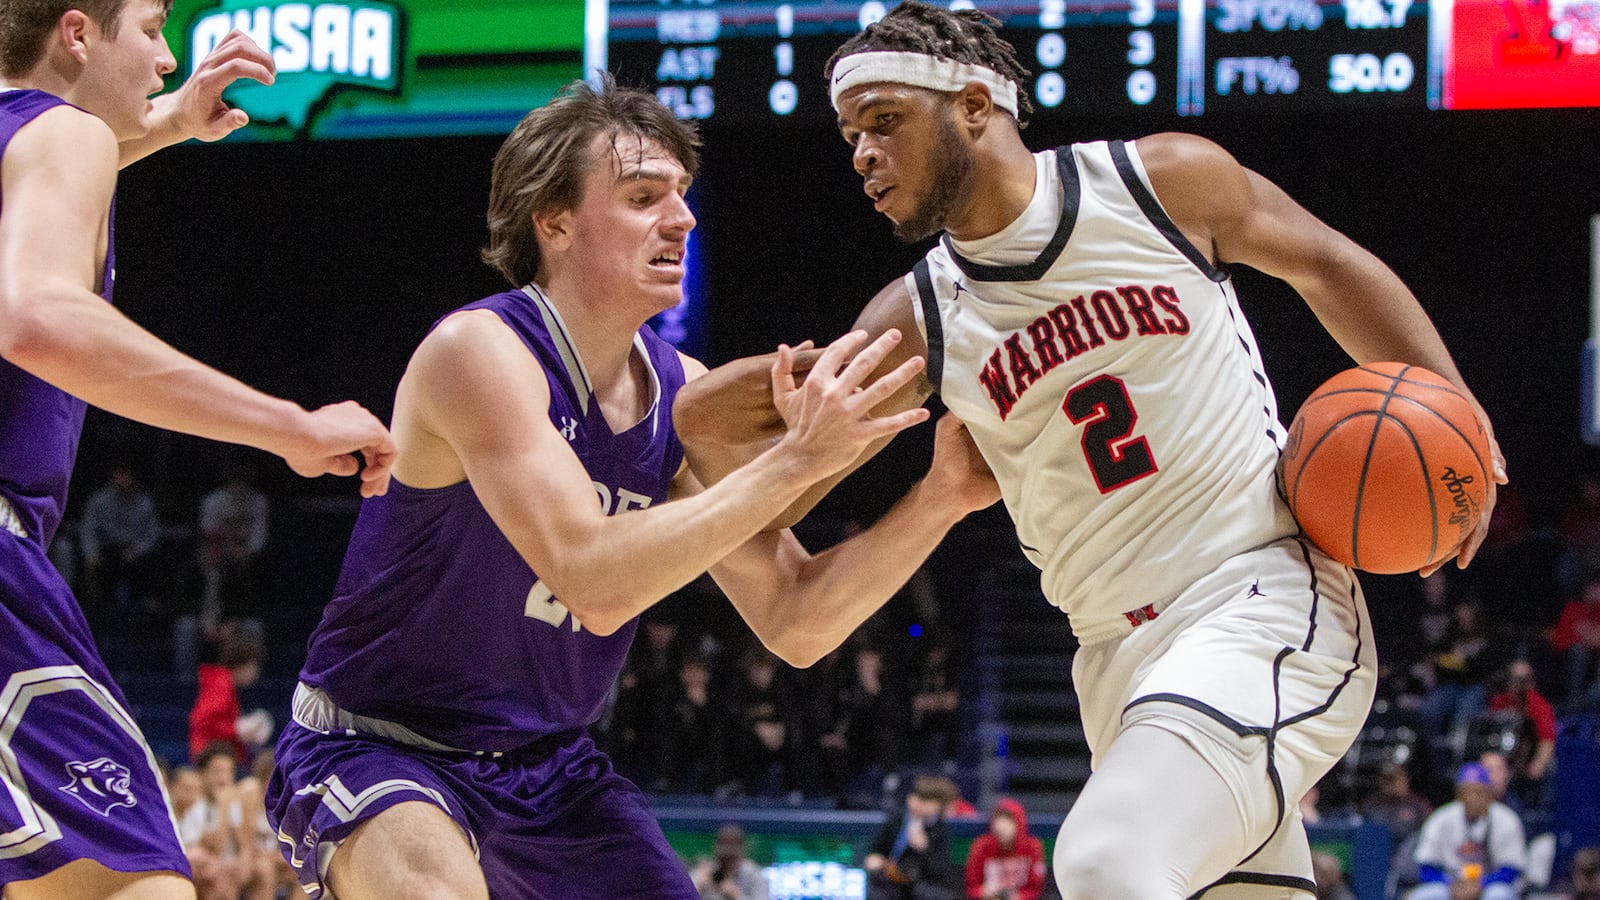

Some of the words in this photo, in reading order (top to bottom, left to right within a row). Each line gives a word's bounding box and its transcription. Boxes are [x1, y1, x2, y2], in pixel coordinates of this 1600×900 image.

[193, 4, 390, 80] OHSAA
[776, 4, 793, 38] 1
[656, 46, 720, 80] AST
[774, 41, 794, 76] 1
[1036, 32, 1066, 69] 0
[1127, 30, 1154, 66] 3
[1215, 56, 1299, 96] FT%
[1328, 52, 1414, 93] 50.0
[768, 80, 798, 115] 0
[1036, 71, 1065, 108] 0
[1127, 68, 1156, 106] 0
[978, 285, 1190, 422] WARRIORS
[1062, 373, 1159, 494] 2
